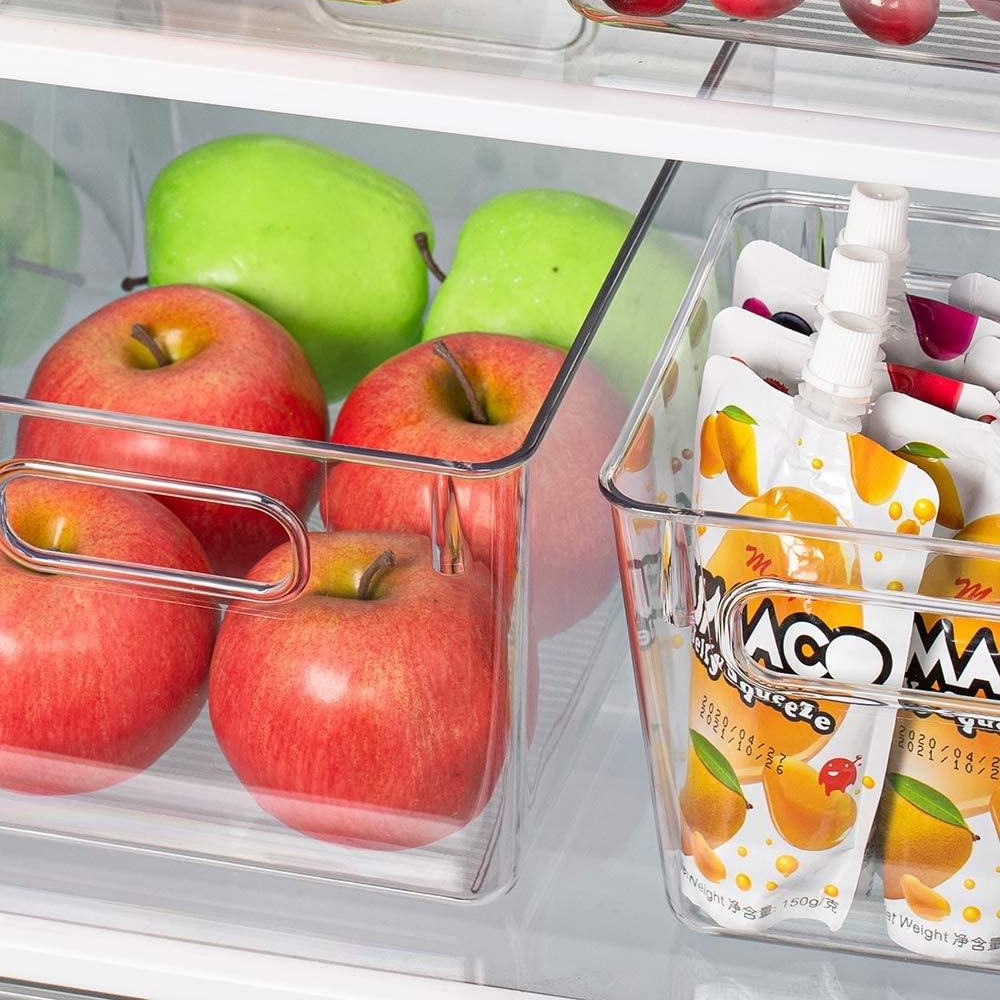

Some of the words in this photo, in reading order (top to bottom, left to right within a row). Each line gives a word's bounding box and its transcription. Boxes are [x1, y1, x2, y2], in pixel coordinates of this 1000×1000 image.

[700, 707, 783, 775] 2021/10/26
[701, 695, 786, 763] 2020/04/27
[899, 725, 1000, 768] 2020/04/2
[898, 737, 1000, 780] 2021/10/2
[900, 914, 949, 942] Weight
